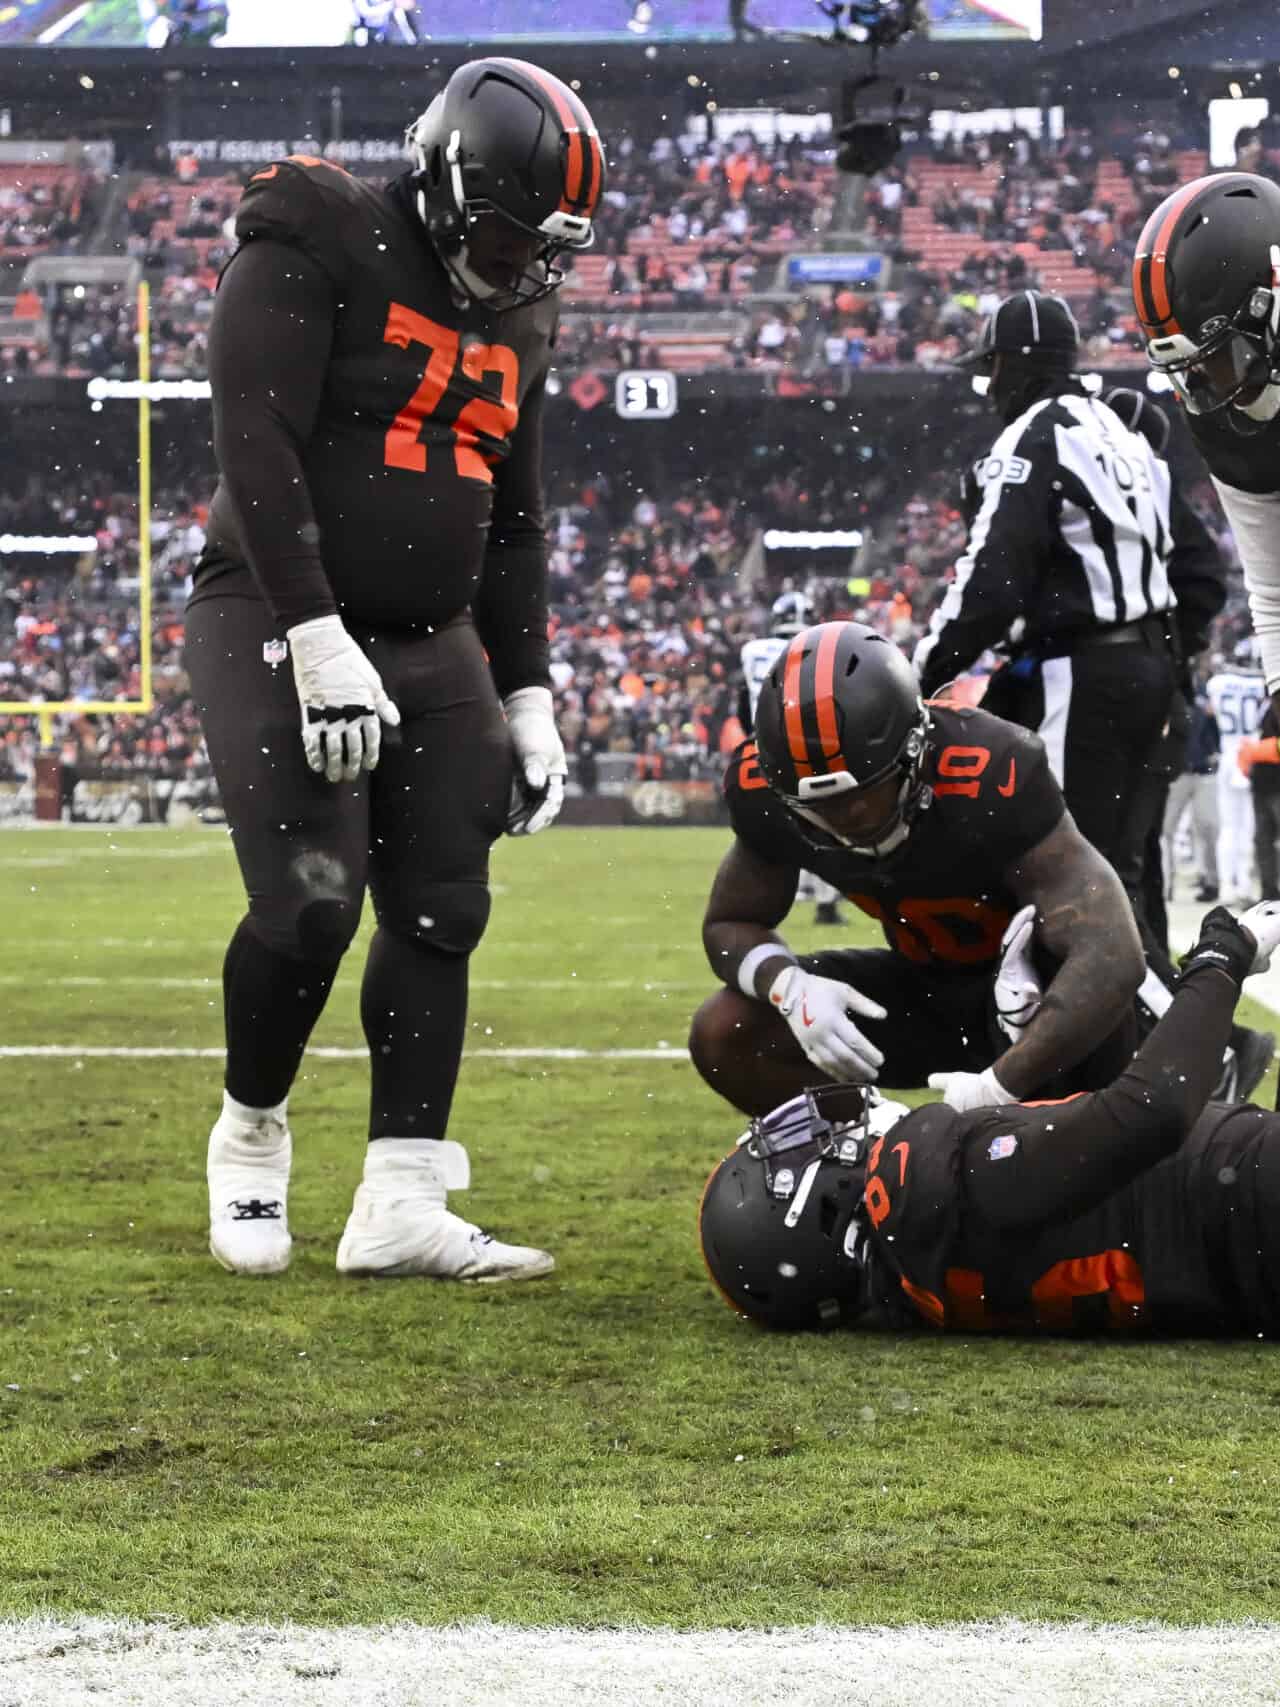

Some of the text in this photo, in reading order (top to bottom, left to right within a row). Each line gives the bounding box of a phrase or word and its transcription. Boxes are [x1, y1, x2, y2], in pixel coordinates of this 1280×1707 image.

[383, 302, 520, 484] 72
[1219, 694, 1260, 735] 50
[933, 745, 992, 799] 10
